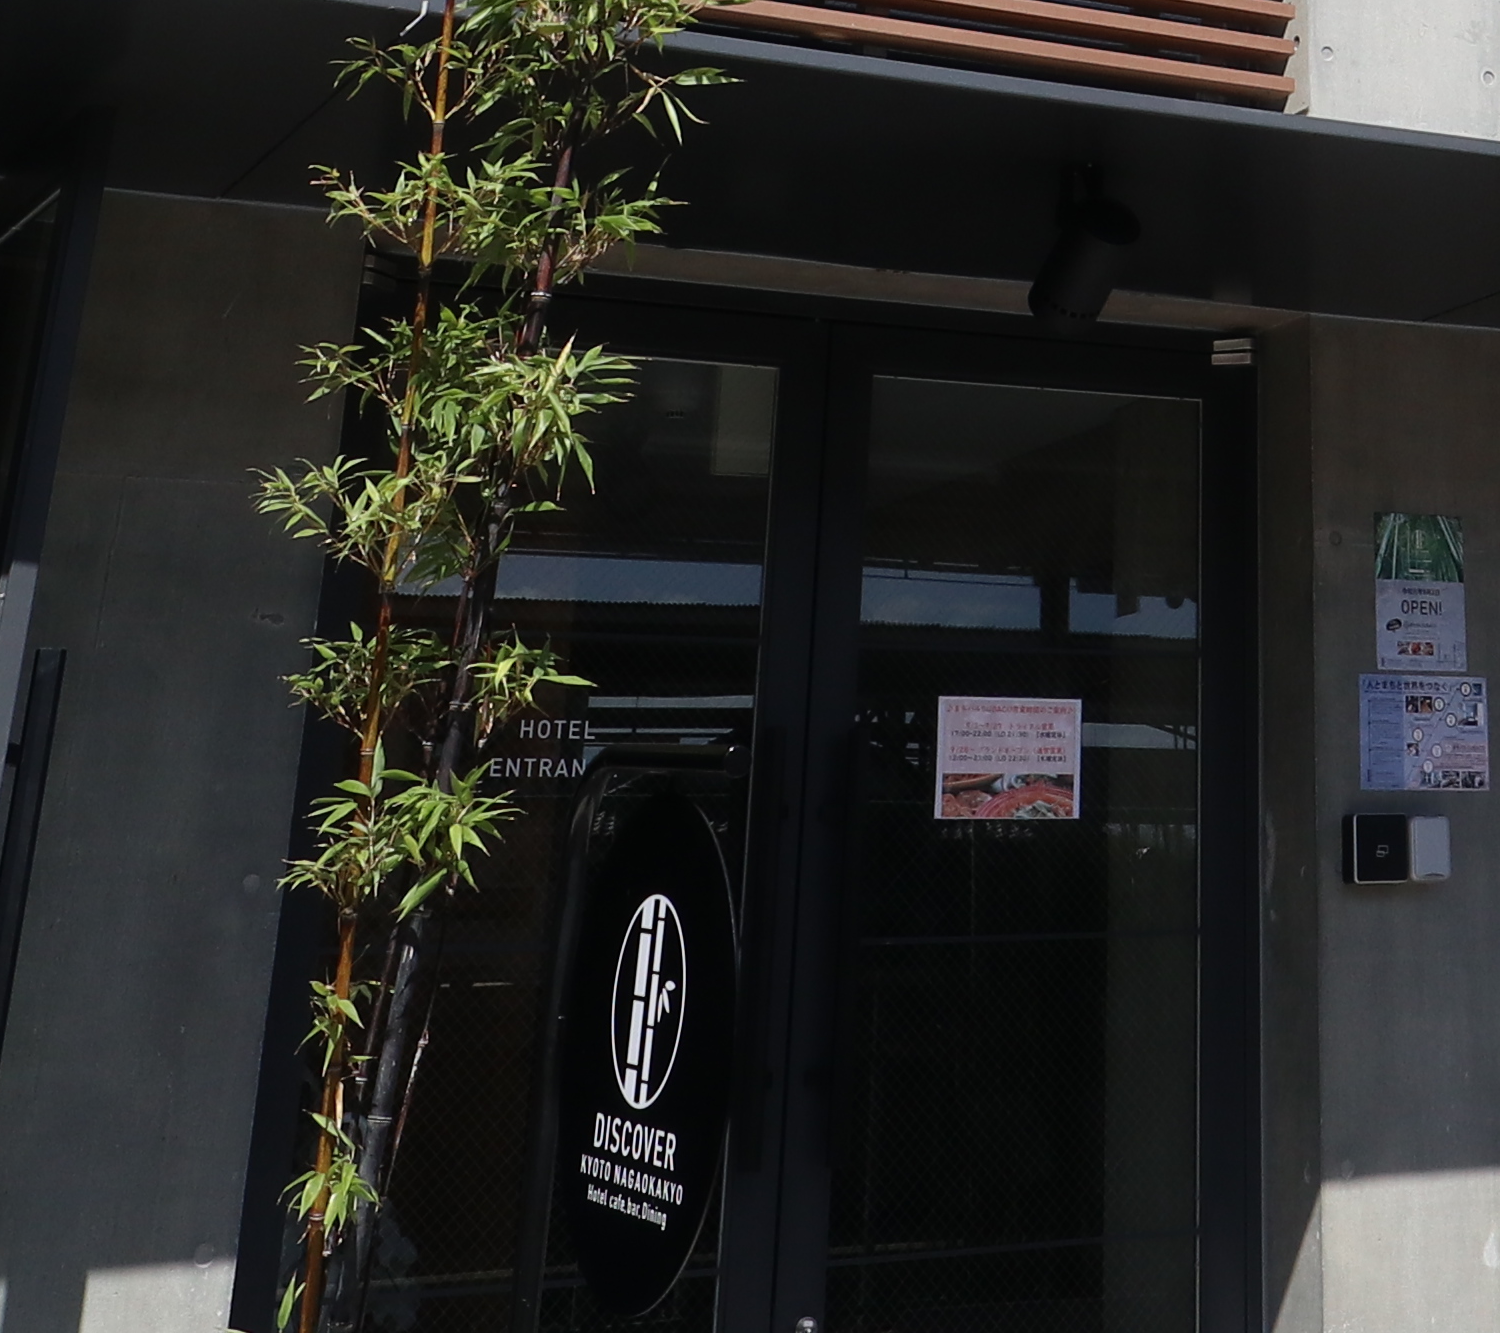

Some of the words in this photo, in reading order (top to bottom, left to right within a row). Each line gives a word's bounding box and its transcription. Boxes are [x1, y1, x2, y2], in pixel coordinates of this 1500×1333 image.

[1401, 599, 1443, 616] OPEN!
[519, 719, 596, 740] HOTEL
[489, 757, 587, 778] ENTRAN
[593, 1112, 677, 1172] DISCOVER
[580, 1153, 612, 1182] KYOTO
[613, 1164, 684, 1206] NAGAOKAKYO
[587, 1183, 609, 1206] Hotel
